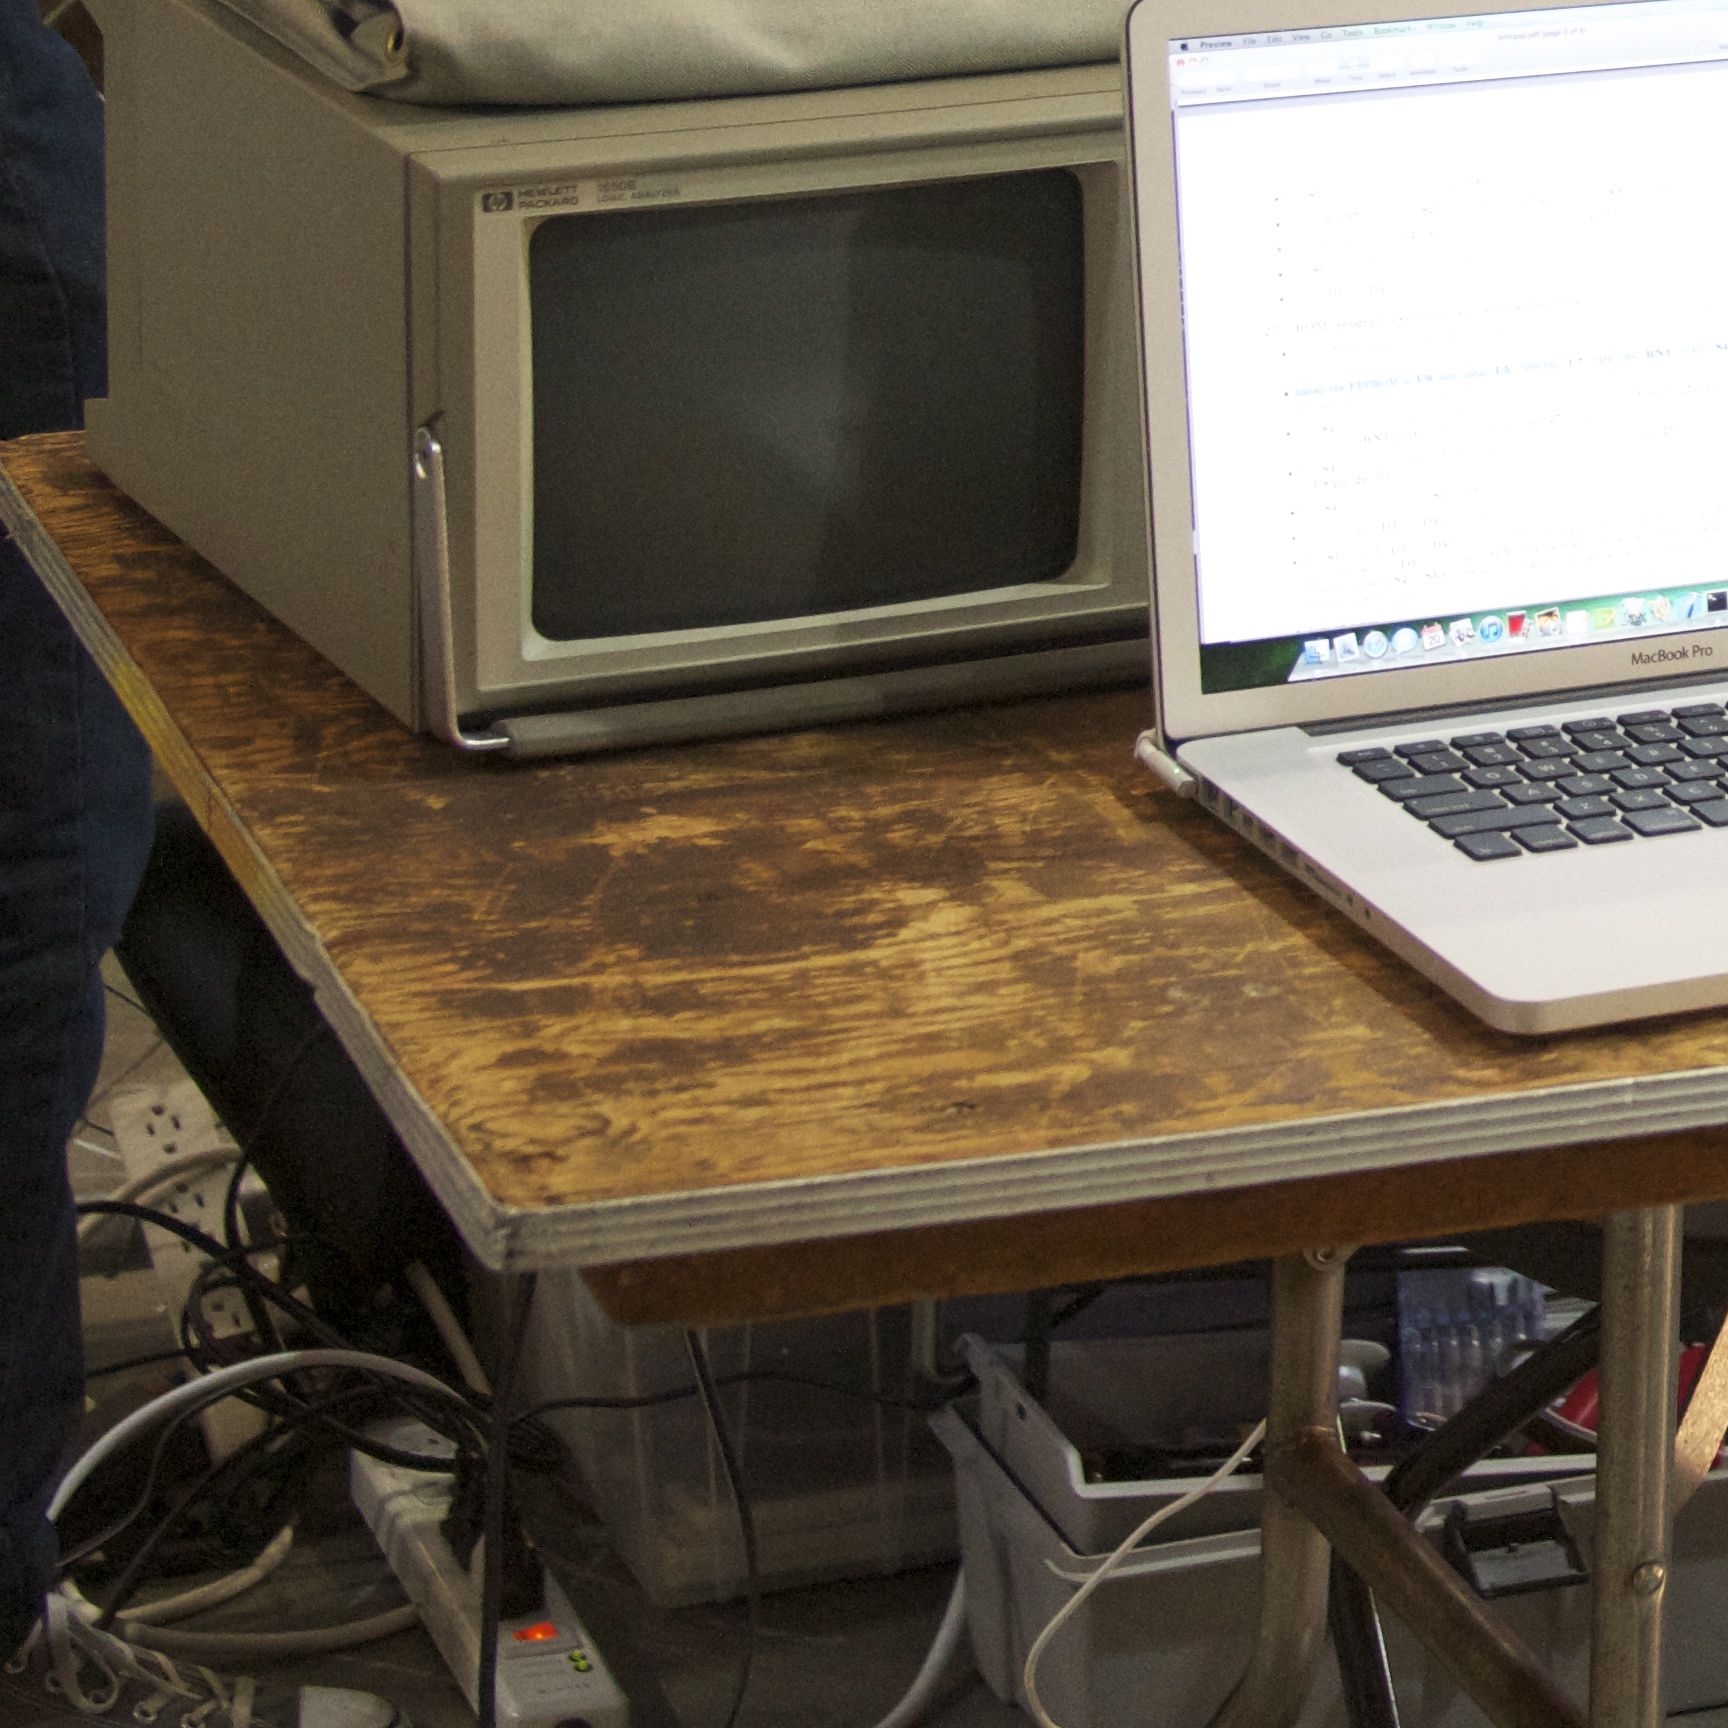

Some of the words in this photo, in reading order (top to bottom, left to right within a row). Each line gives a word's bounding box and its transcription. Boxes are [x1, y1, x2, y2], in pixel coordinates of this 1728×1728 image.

[1200, 39, 1232, 49] Preview
[1243, 37, 1257, 46] File
[1267, 35, 1282, 45] Edit
[1292, 32, 1311, 42] View
[1321, 30, 1333, 40] Go
[1343, 28, 1363, 38] Tools
[1427, 21, 1456, 31] Window
[1466, 18, 1484, 28] Help
[519, 184, 578, 198] HEWLETT
[519, 196, 579, 210] PACKARD
[1428, 635, 1441, 646] 20
[1631, 646, 1689, 666] MacBook
[1692, 644, 1713, 657] Pro
